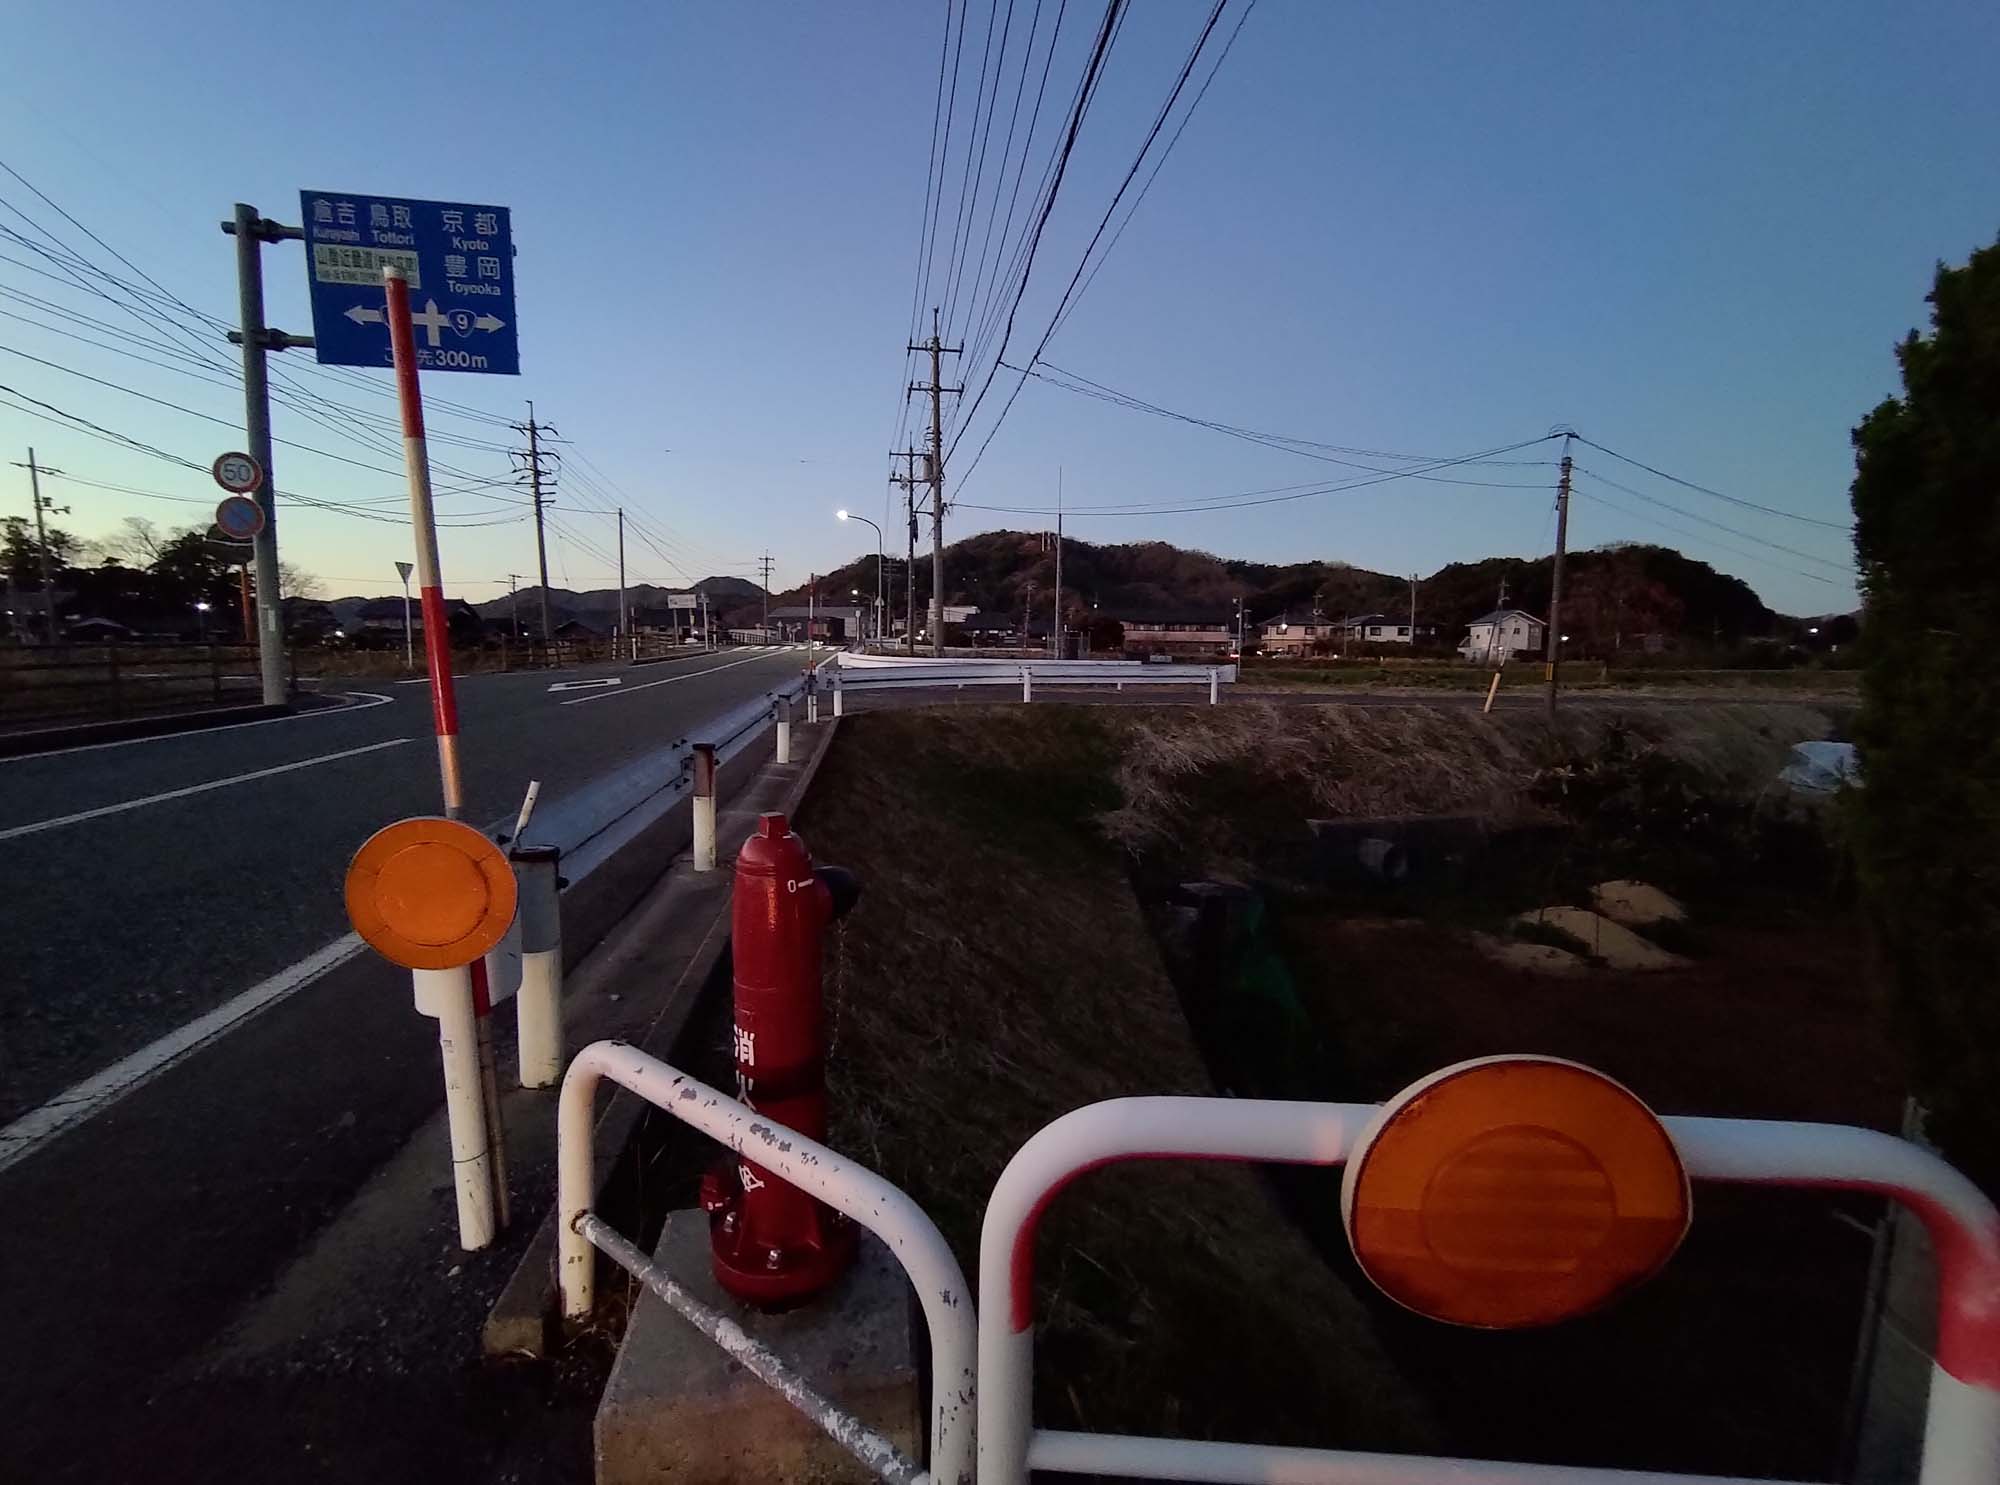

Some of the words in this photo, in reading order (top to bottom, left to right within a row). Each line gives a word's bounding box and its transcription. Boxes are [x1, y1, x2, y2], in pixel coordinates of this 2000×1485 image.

[312, 198, 356, 226] 倉吉
[370, 203, 413, 229] 鳥取
[441, 209, 498, 236] 京都
[372, 230, 415, 246] Tottori
[452, 236, 489, 252] Kyoto
[445, 254, 501, 280] 豊岡
[447, 279, 502, 297] Toyooka
[456, 314, 468, 330] 9
[224, 463, 250, 482] 50
